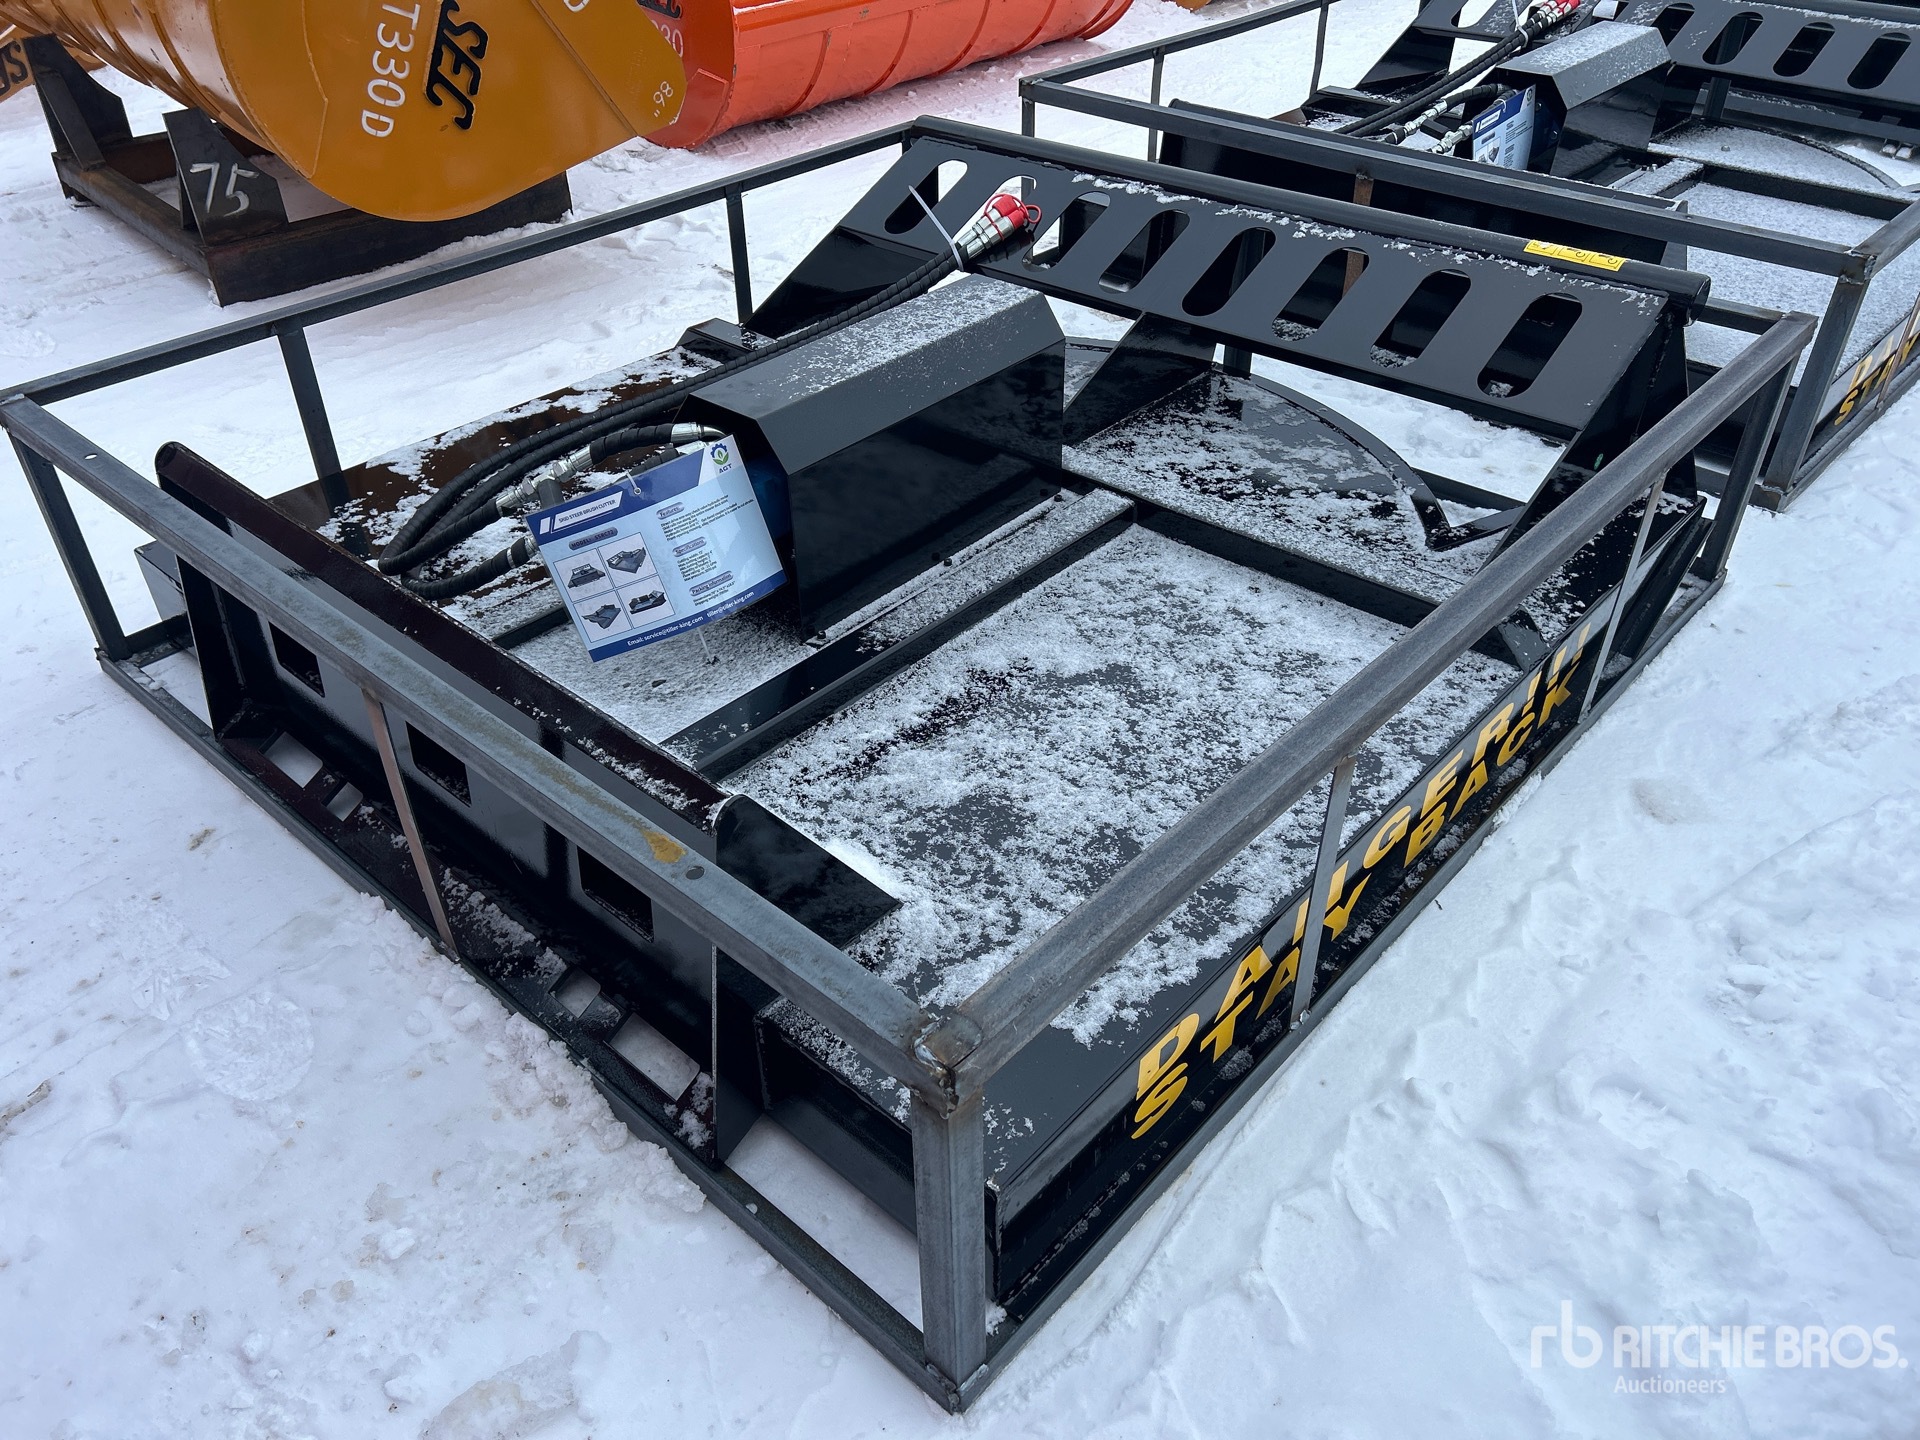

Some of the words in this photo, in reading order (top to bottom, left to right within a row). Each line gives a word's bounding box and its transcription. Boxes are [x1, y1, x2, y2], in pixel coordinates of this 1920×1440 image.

[187, 161, 261, 218] 75
[569, 511, 584, 519] STEER
[583, 505, 599, 514] BRUSH
[599, 499, 617, 509] CUTTER
[627, 636, 644, 646] Email:
[1130, 873, 1373, 1140] STAY
[1403, 666, 1579, 868] BACK
